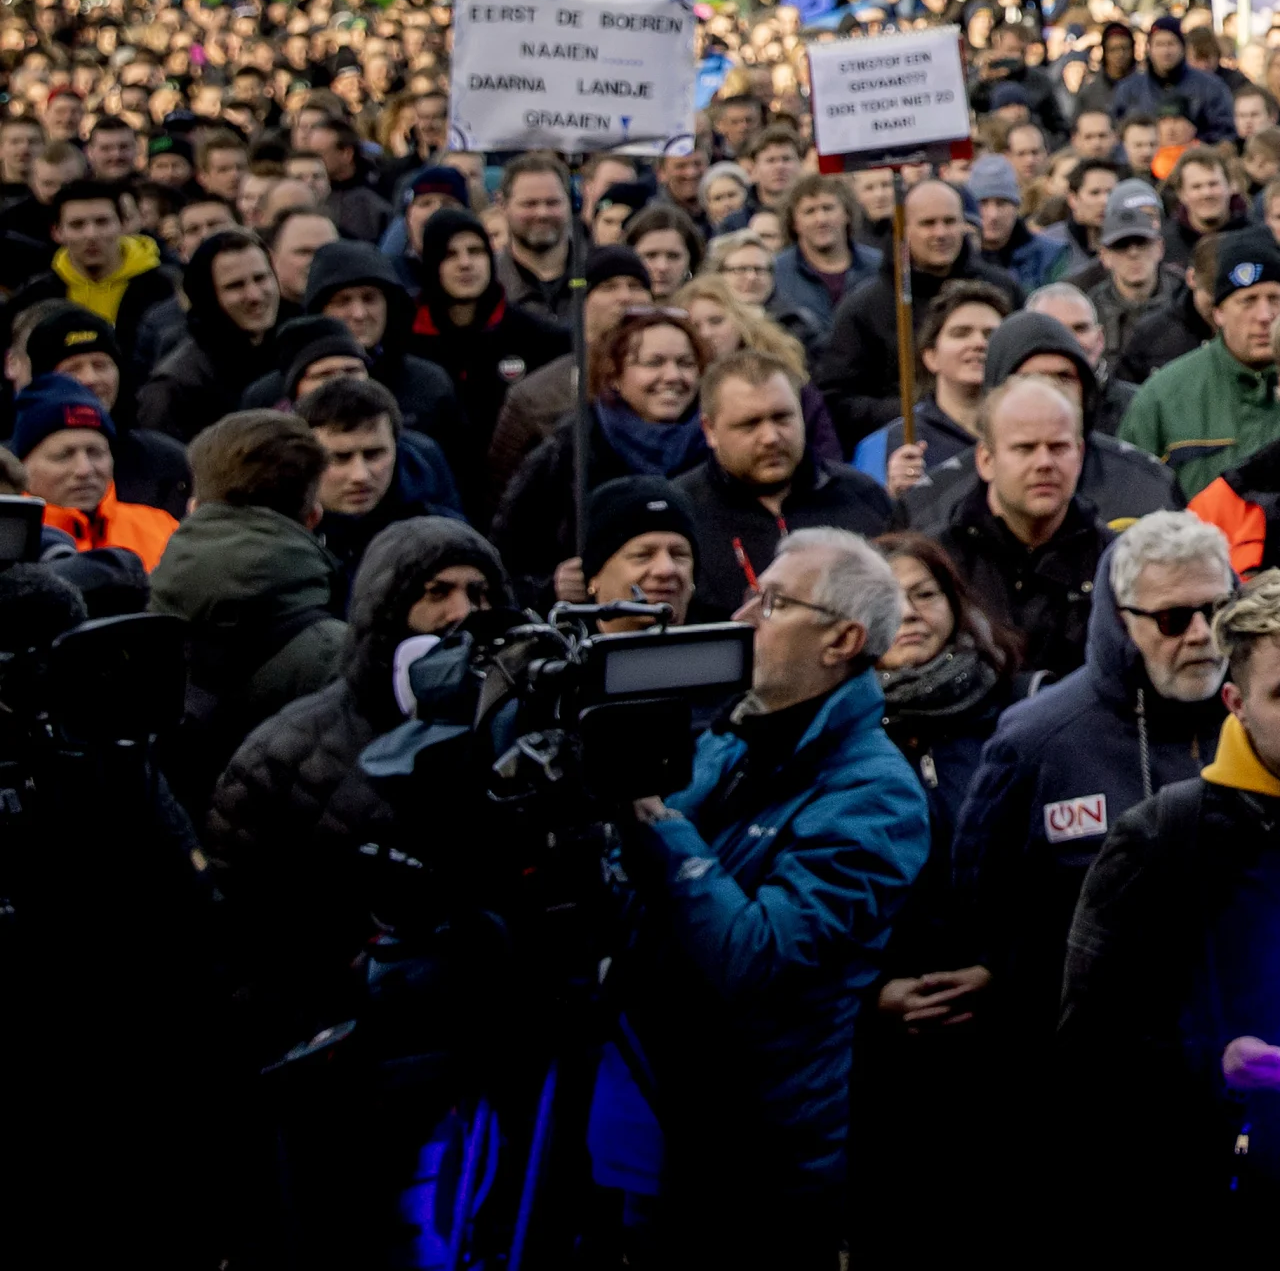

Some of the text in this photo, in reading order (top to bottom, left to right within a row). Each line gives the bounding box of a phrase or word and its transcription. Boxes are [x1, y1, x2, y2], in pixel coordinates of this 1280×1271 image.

[469, 5, 683, 34] EERST DE BOEREN
[469, 73, 655, 99] DAARNA LANDJE
